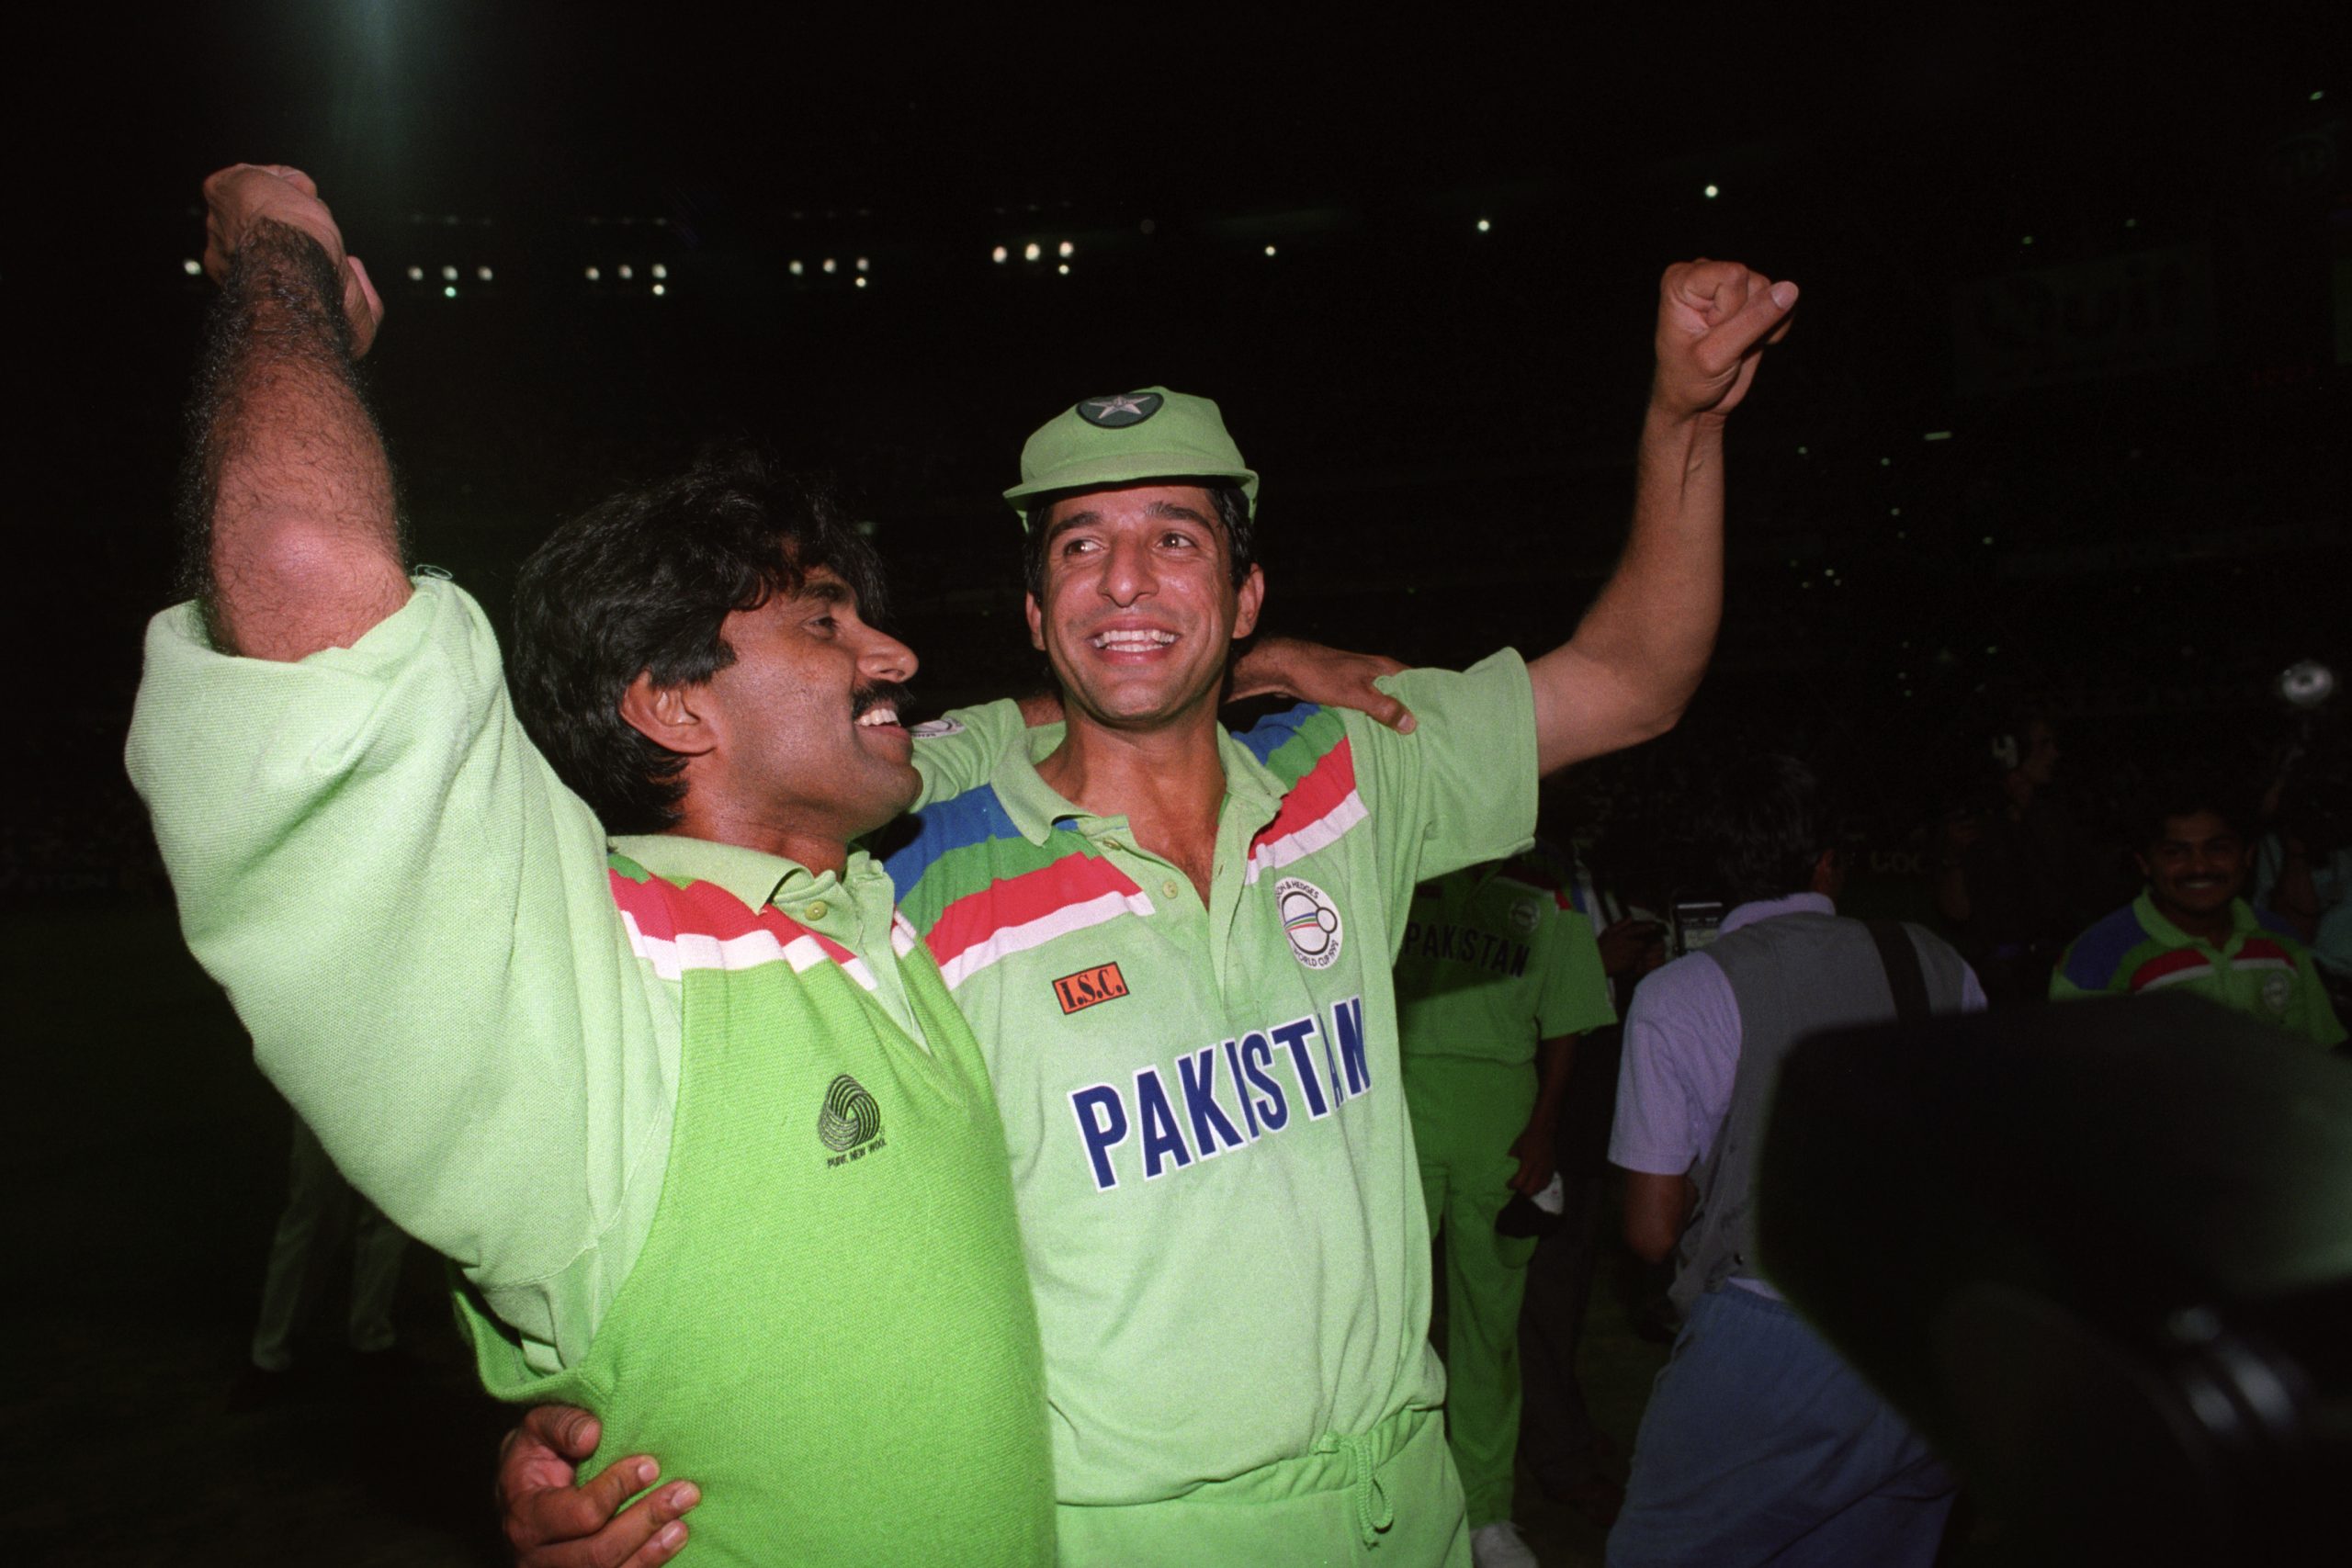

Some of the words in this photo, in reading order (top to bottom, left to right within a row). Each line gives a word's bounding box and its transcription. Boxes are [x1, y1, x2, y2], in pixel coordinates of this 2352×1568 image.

[1291, 880, 1320, 899] HEDGES
[1404, 921, 1532, 978] PAKSTAN
[1059, 968, 1123, 1010] I.S.C.
[1068, 995, 1372, 1192] PAKISTAN
